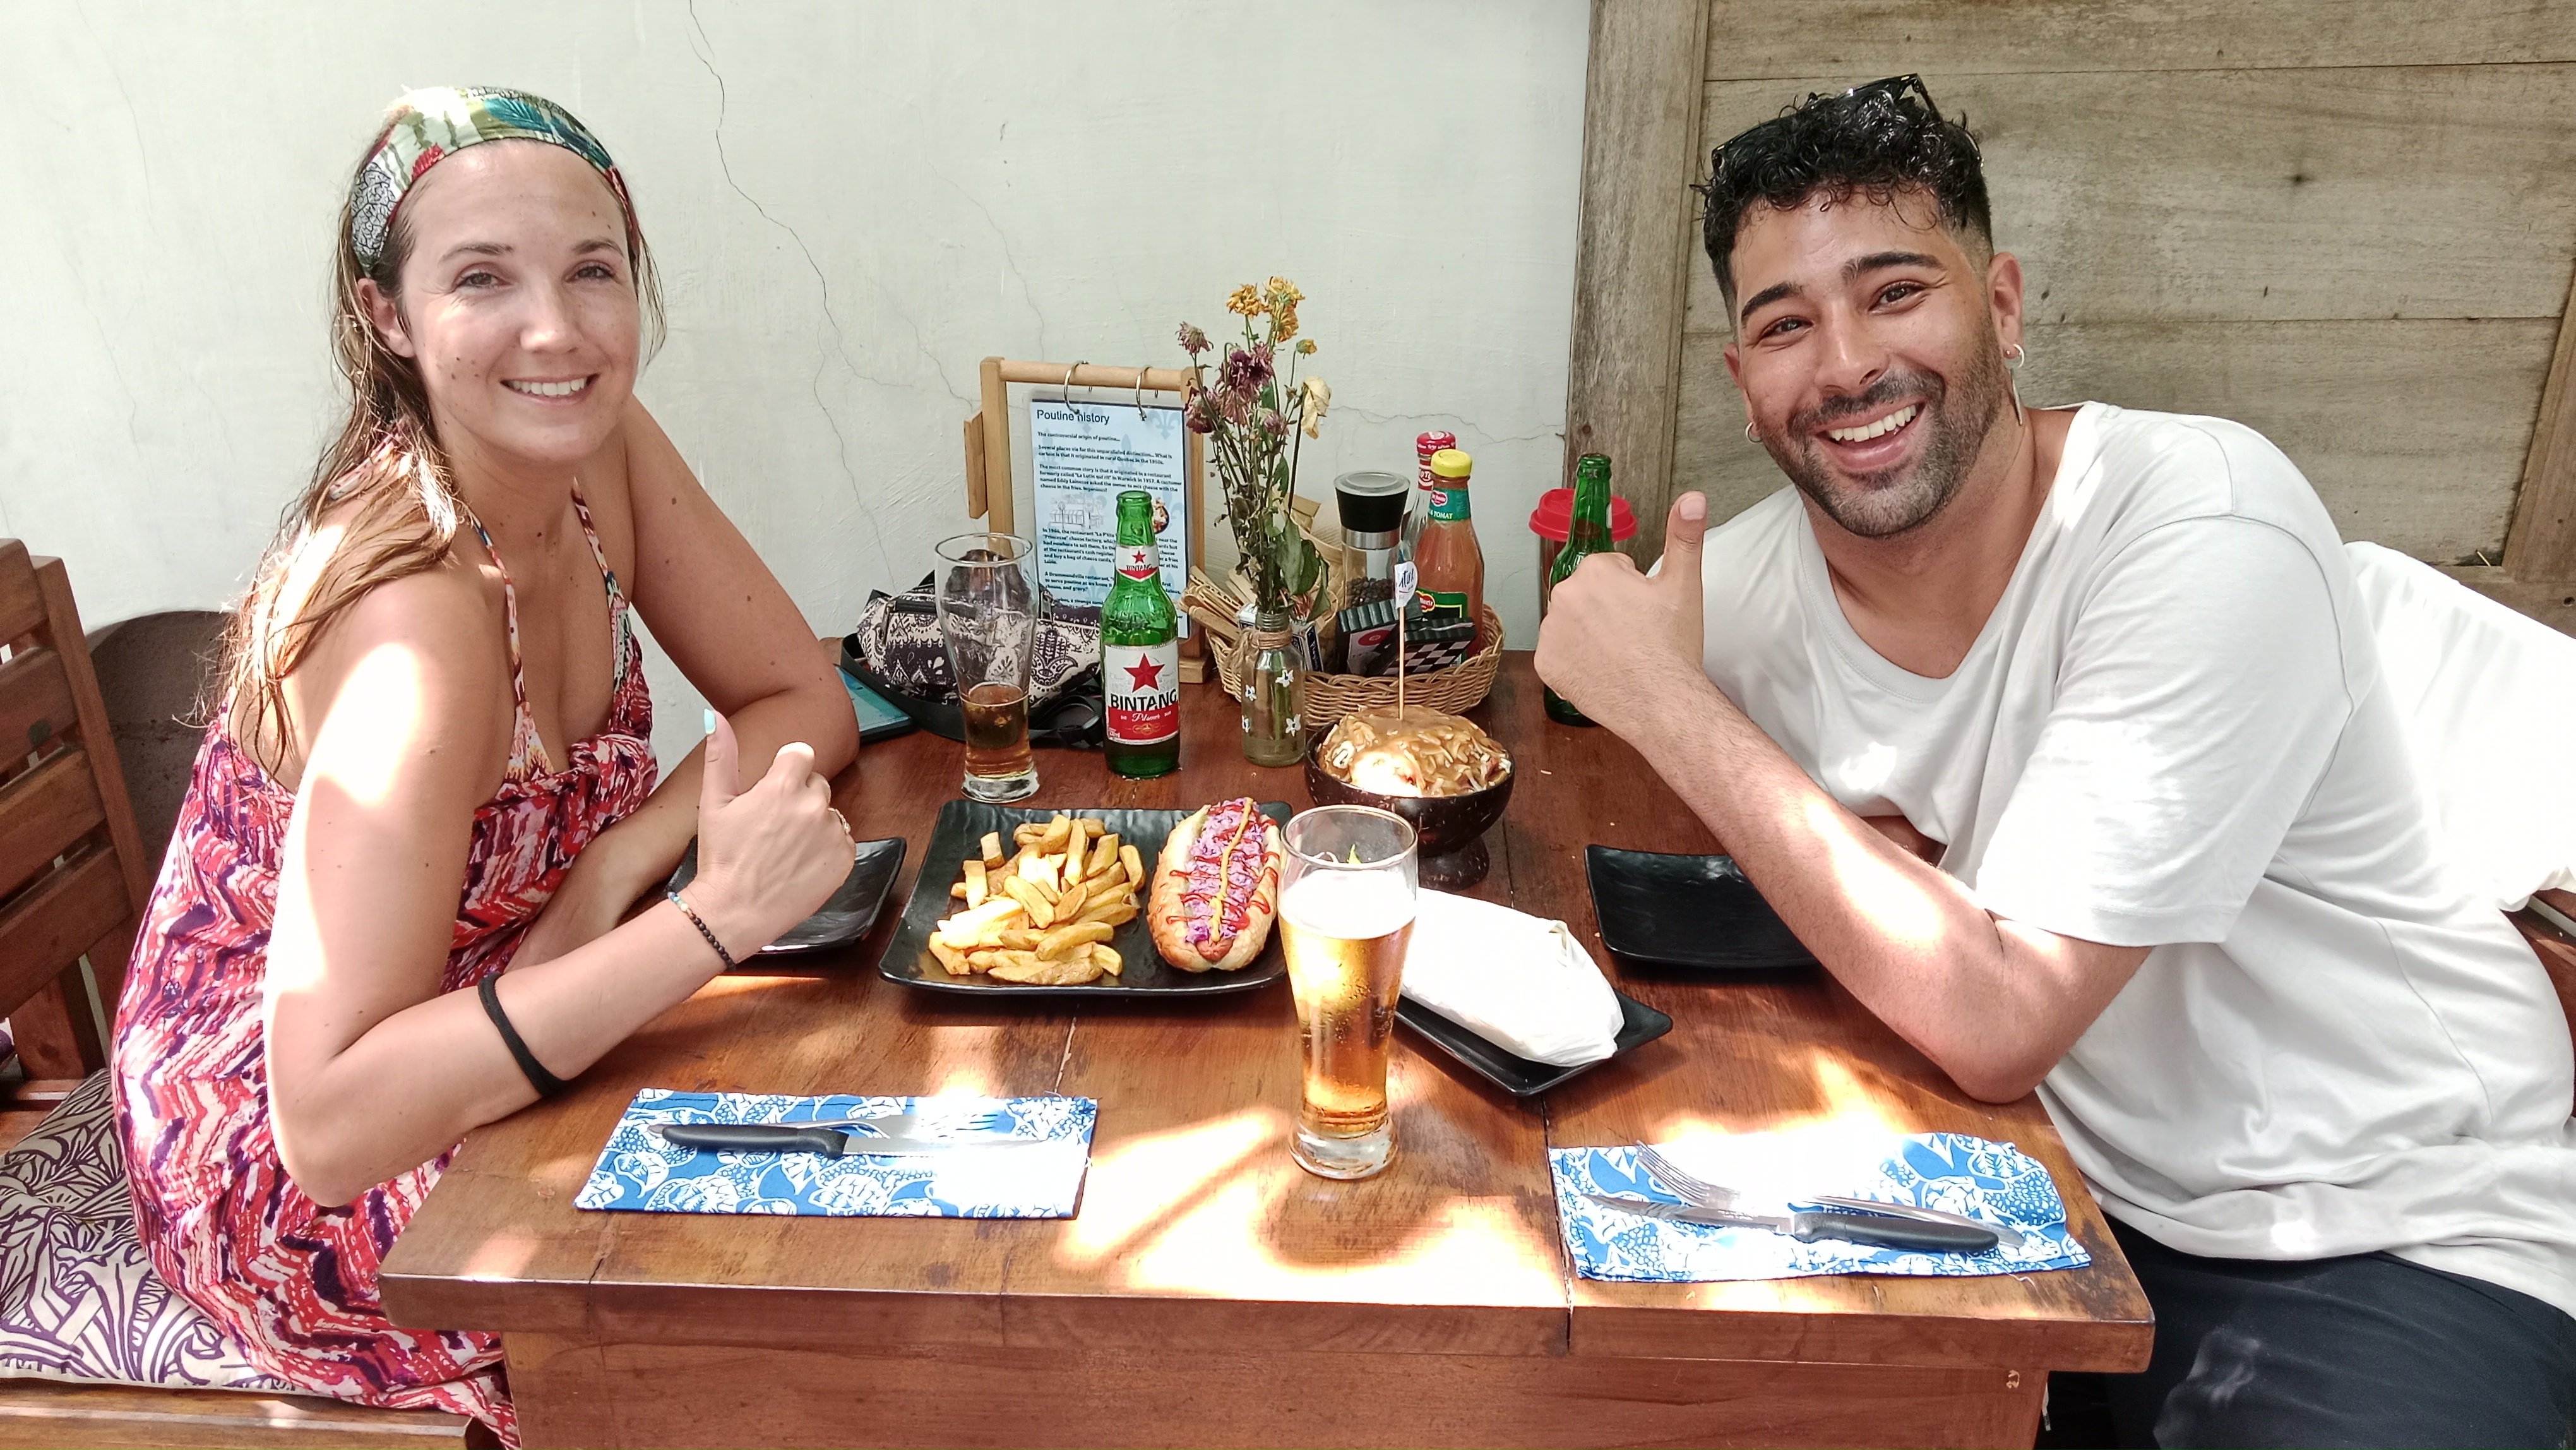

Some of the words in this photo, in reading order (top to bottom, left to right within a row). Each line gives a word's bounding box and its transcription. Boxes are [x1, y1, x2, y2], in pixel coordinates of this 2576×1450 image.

[1037, 409, 1074, 421] Poutine
[1077, 412, 1110, 426] history
[1433, 511, 1453, 519] TOMAT
[1126, 563, 1152, 572] BINTANG
[1111, 688, 1177, 711] BINTANG
